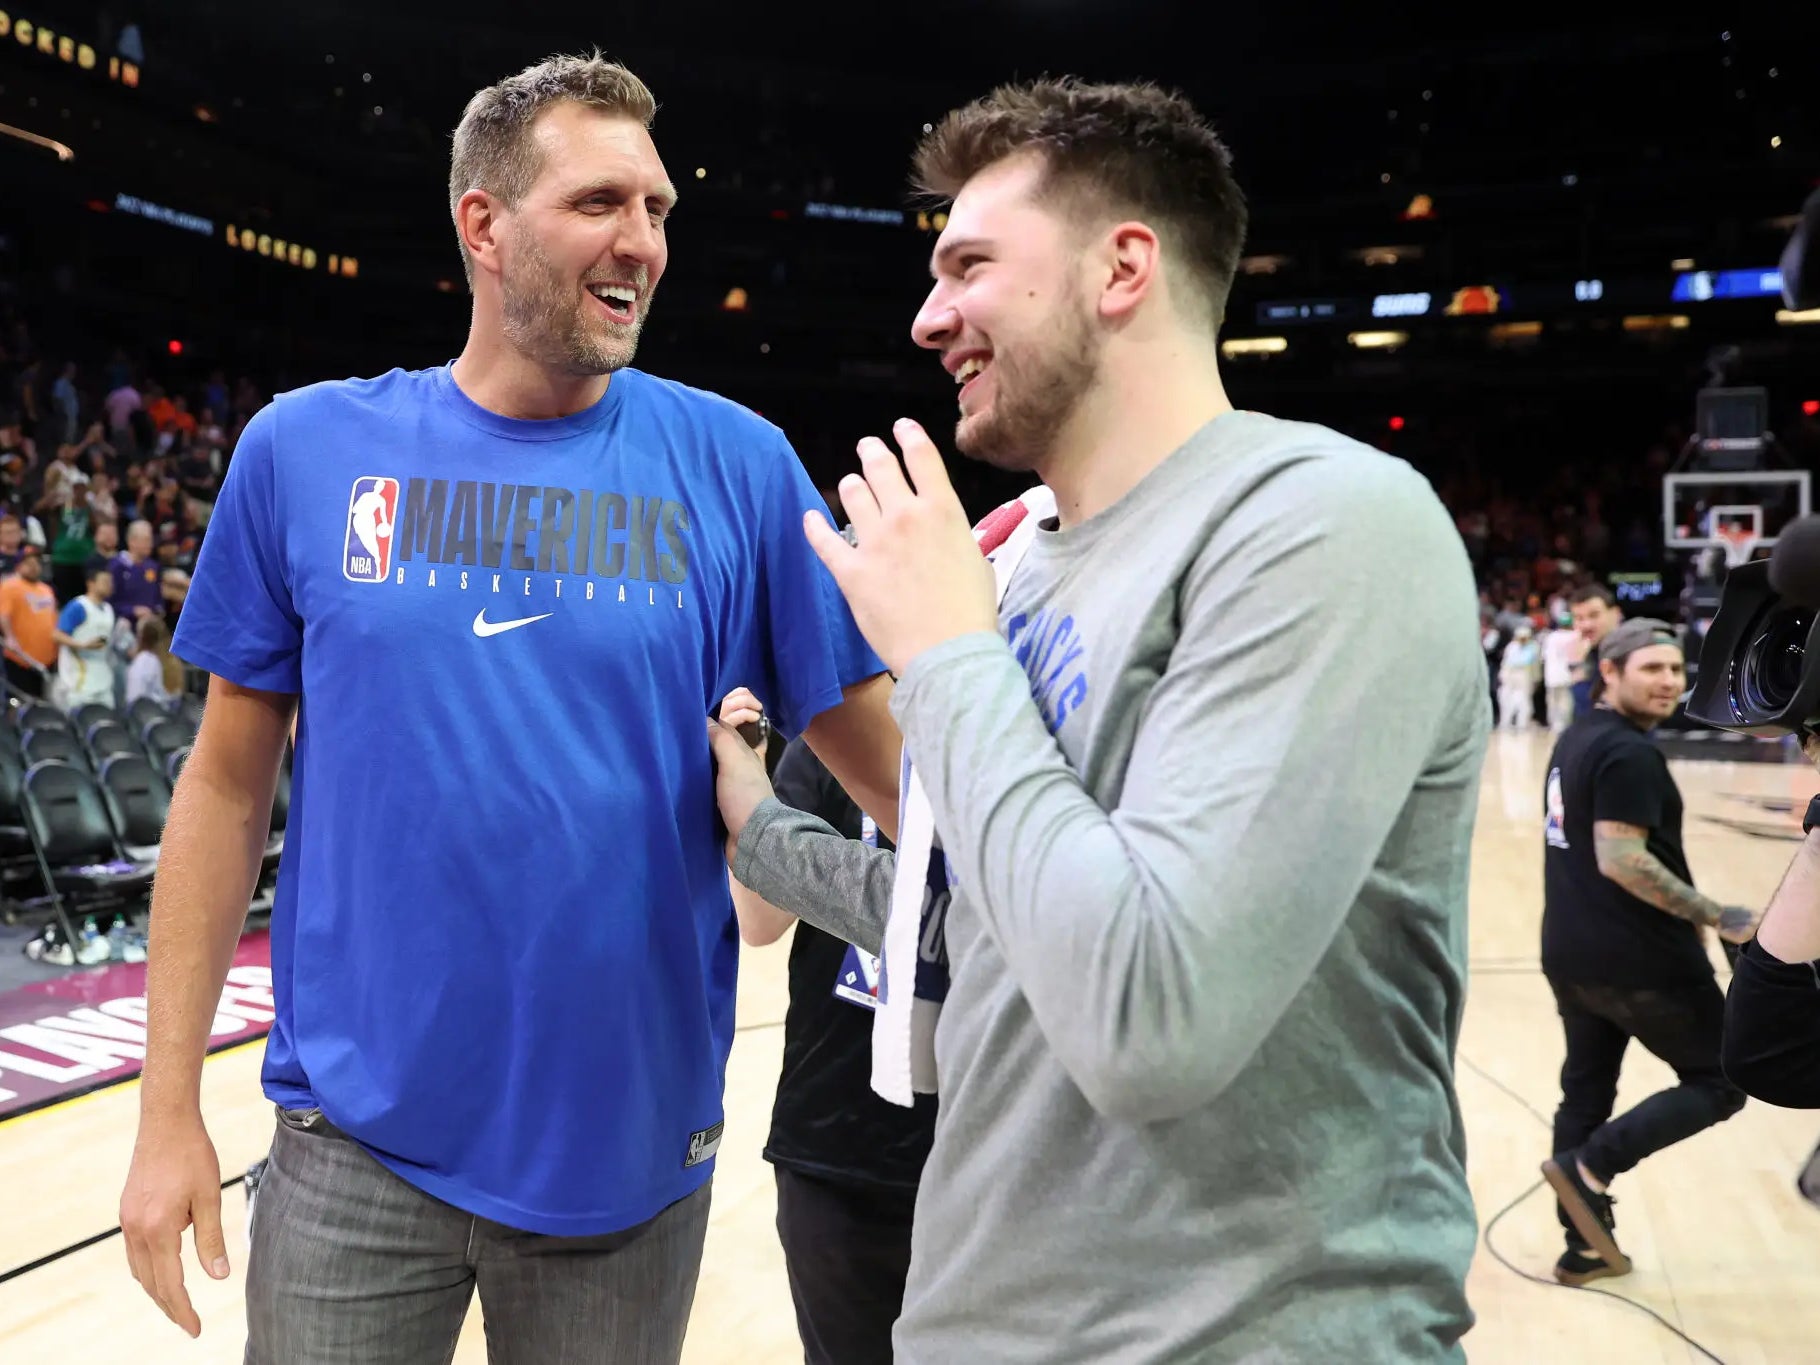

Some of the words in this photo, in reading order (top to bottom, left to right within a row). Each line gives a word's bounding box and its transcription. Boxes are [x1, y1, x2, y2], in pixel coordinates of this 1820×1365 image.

[109, 56, 139, 88] IN
[226, 223, 317, 270] LOCKED
[328, 254, 358, 277] IN
[400, 477, 691, 584] MAVERICKS
[350, 555, 372, 575] NBA
[396, 566, 684, 608] BASKETBALL
